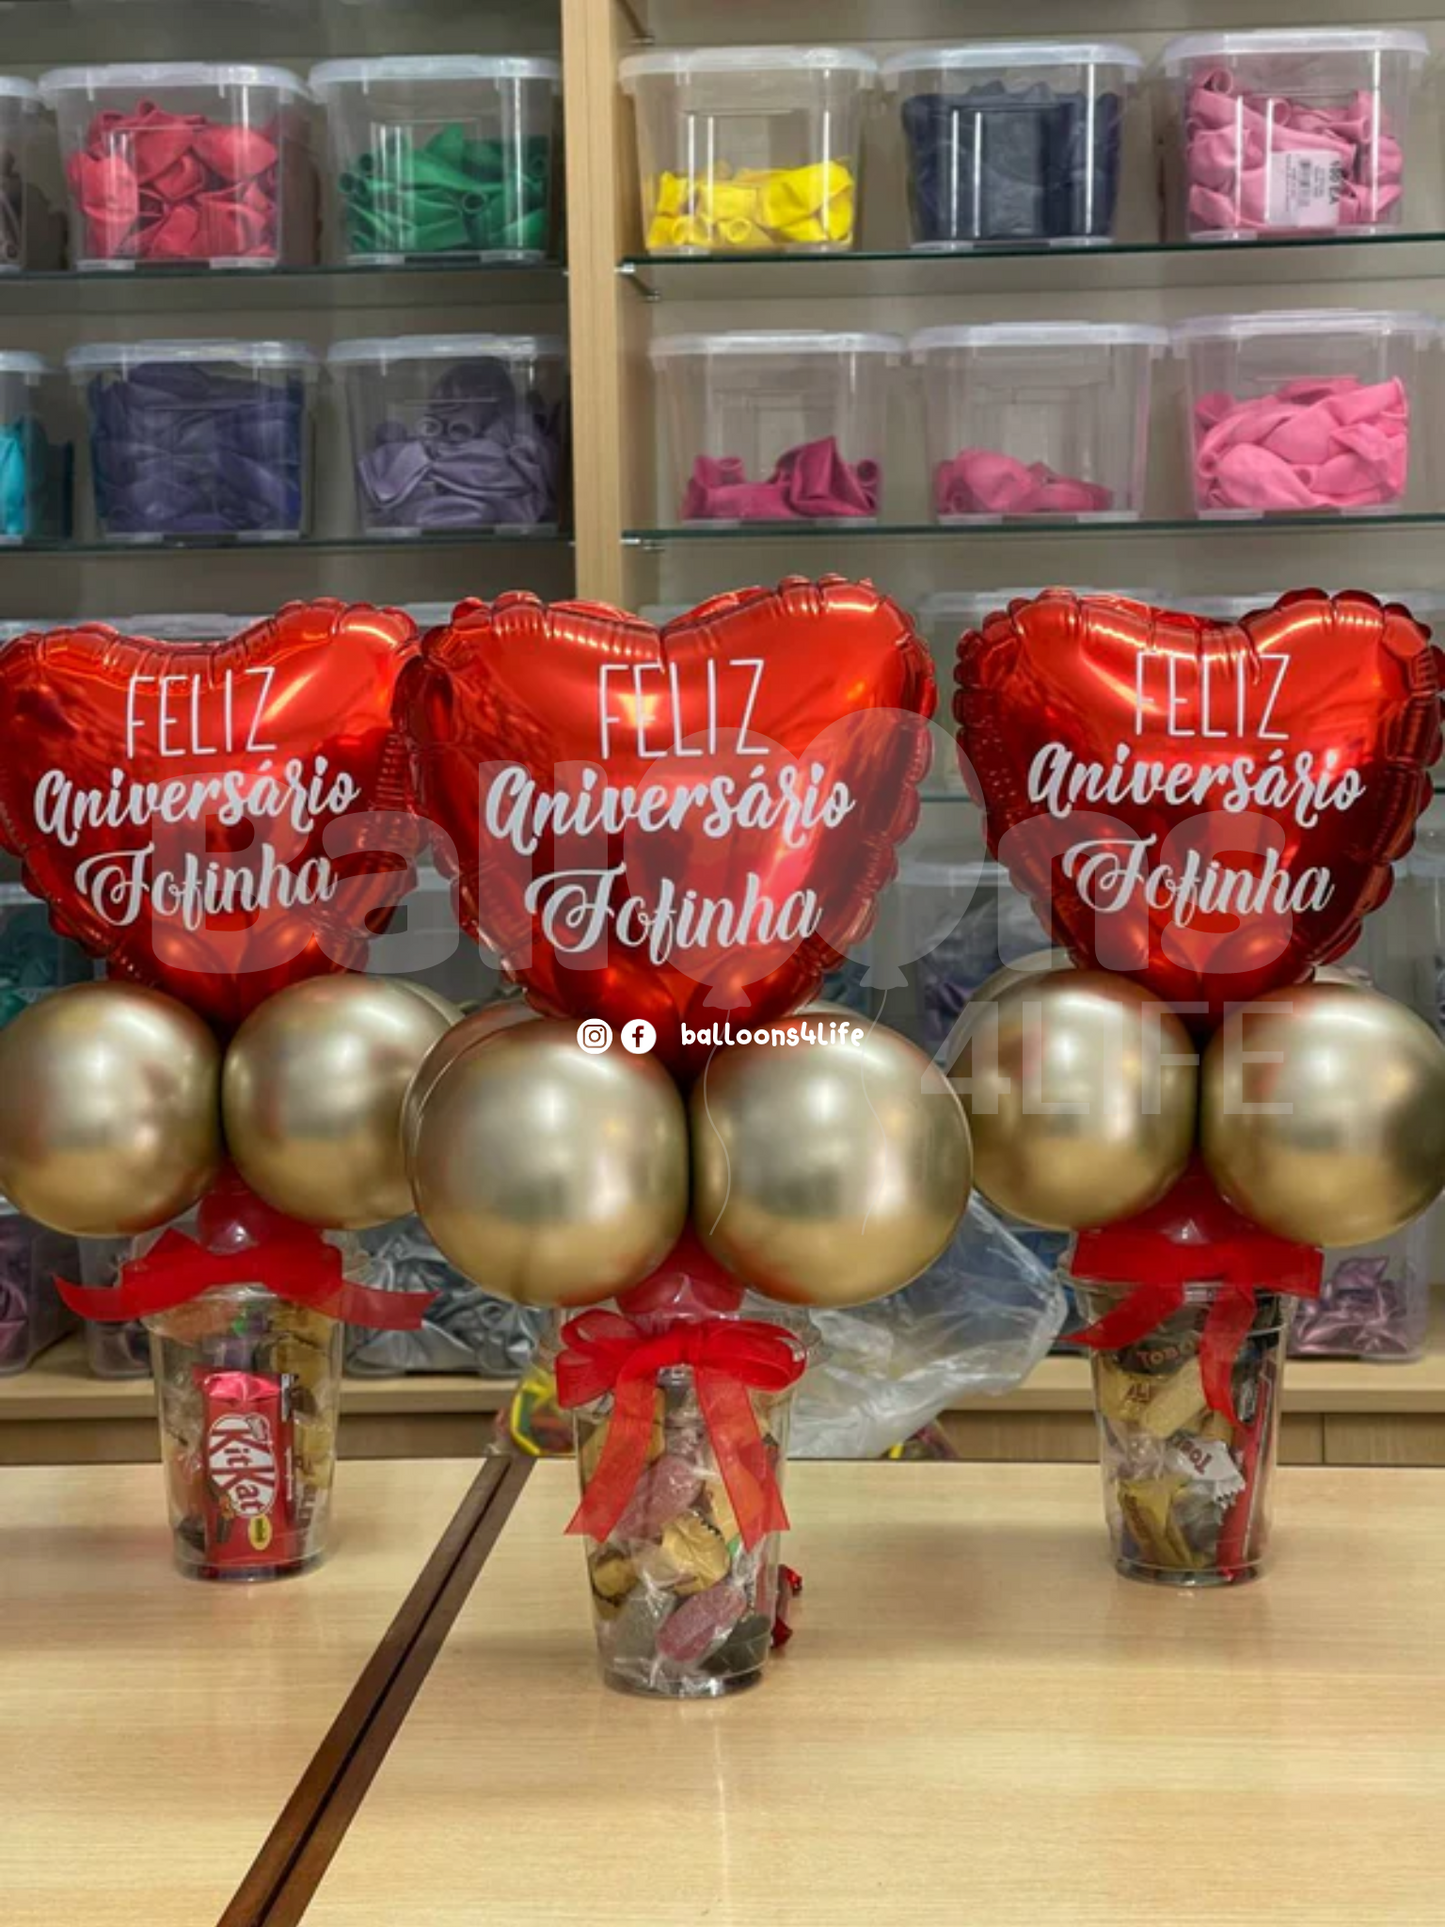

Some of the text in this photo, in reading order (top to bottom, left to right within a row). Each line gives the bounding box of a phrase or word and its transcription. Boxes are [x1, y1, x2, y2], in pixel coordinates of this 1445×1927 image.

[126, 666, 278, 760] FELIZ
[598, 658, 770, 760] FELIZ
[1134, 651, 1291, 742] FELIZ
[208, 1428, 277, 1512] KitKat
